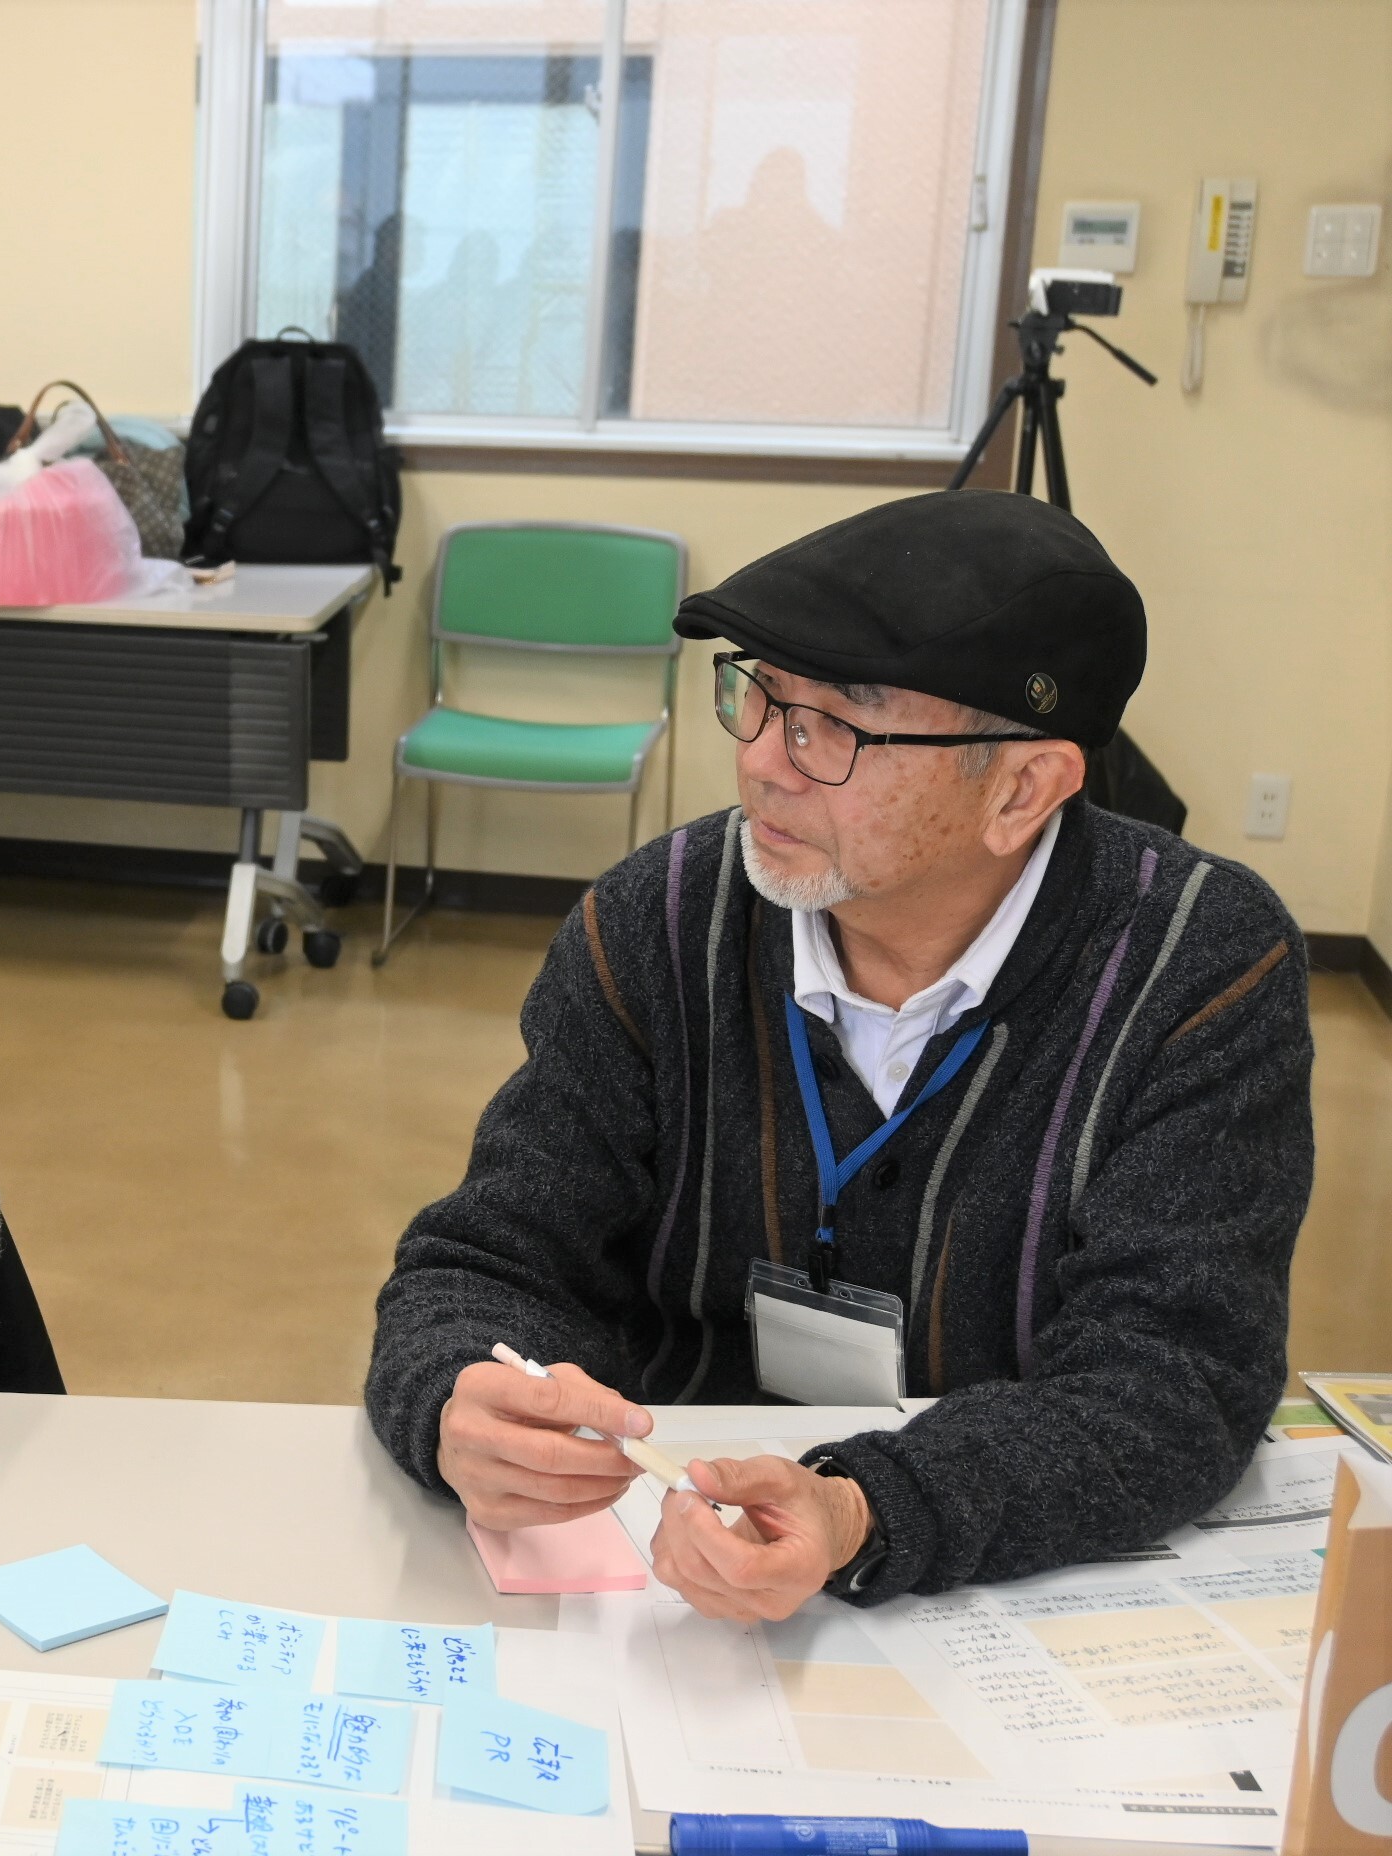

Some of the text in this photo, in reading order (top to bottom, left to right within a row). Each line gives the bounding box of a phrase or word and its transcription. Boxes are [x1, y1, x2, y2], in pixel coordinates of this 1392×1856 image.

[217, 1608, 235, 1641] しくみ
[342, 1710, 382, 1782] 魅力的な
[480, 1730, 512, 1763] PR
